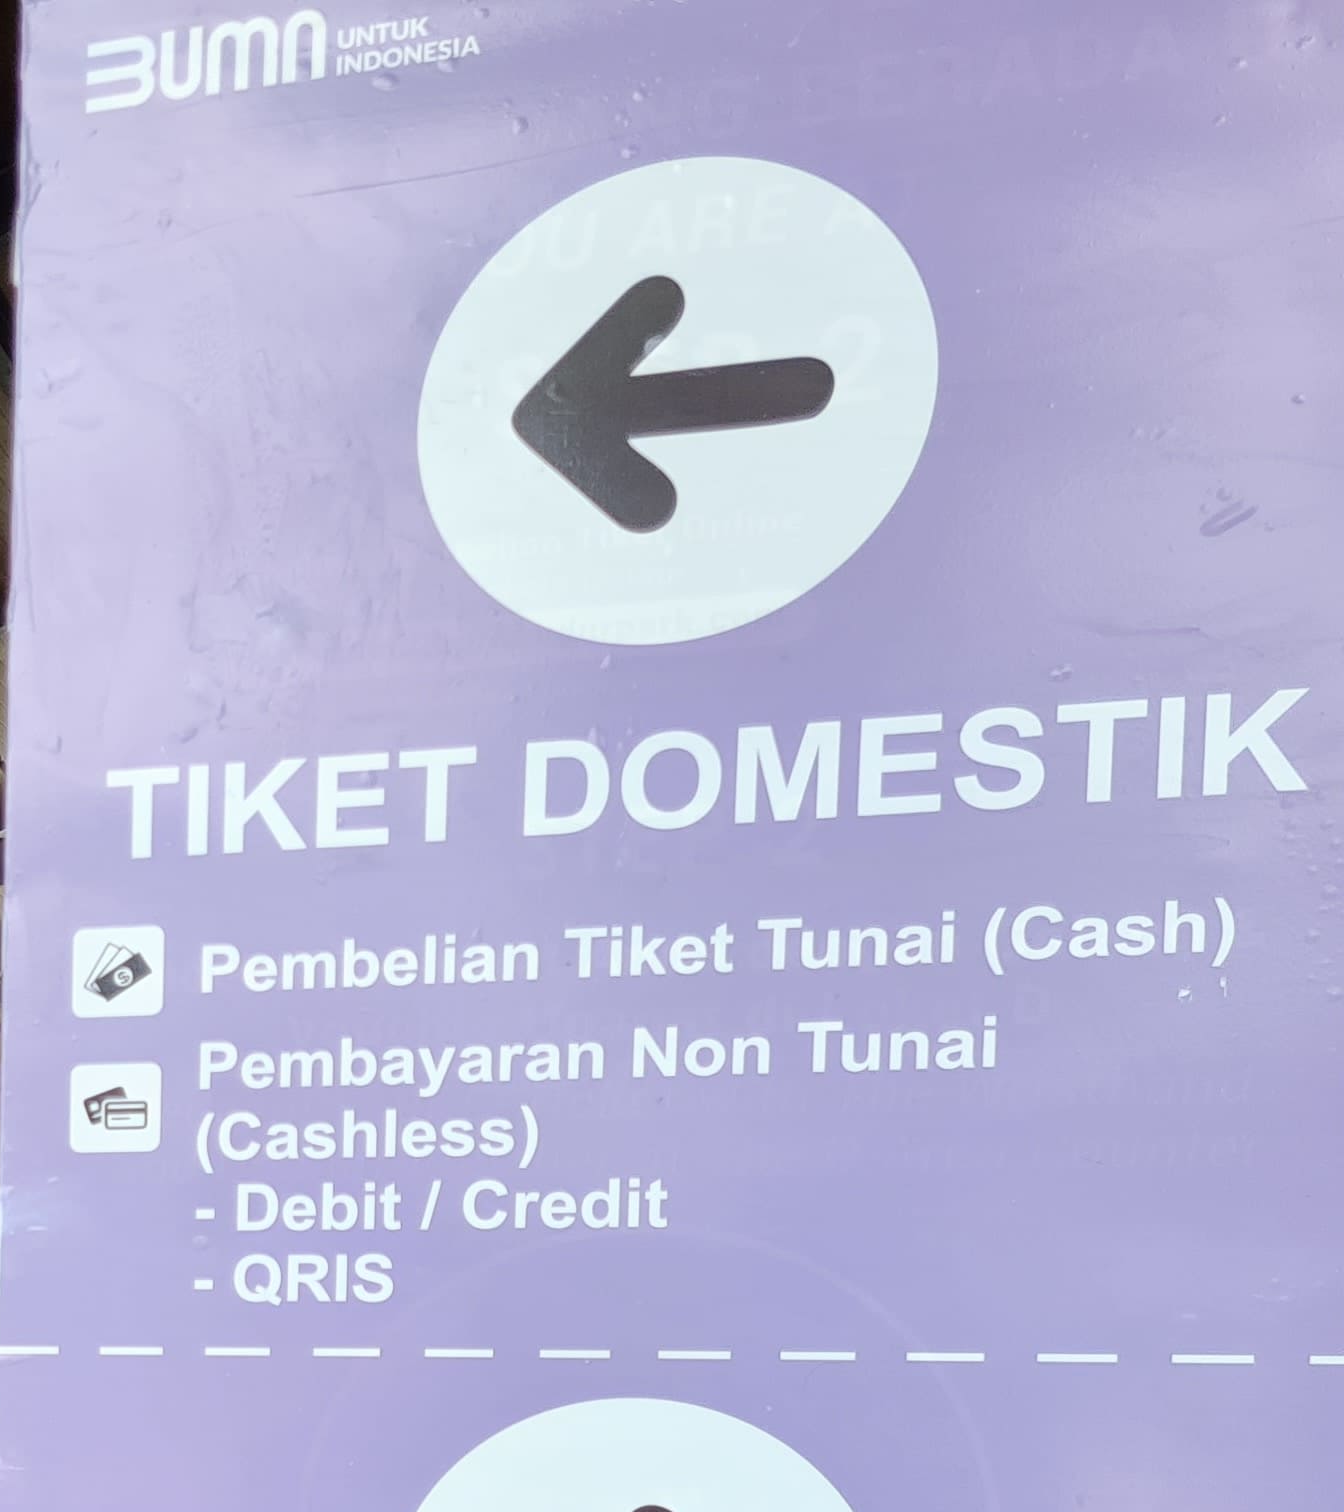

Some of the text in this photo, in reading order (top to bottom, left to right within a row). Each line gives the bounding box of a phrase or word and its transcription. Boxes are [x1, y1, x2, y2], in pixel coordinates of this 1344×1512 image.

[335, 35, 480, 77] INDONESIA
[336, 15, 429, 51] UNTUK
[103, 744, 479, 861] TIKET
[522, 686, 1311, 838] DOMESTIK
[199, 896, 1236, 995] Pembelian Tiket Tunai (Cash)
[197, 1019, 998, 1099] Pembayaran Non Tunai
[194, 1103, 540, 1175] (Cashless)
[235, 1180, 403, 1233] Debit
[418, 1178, 443, 1232] /
[461, 1176, 669, 1231] Credit
[231, 1252, 395, 1307] QRIS
